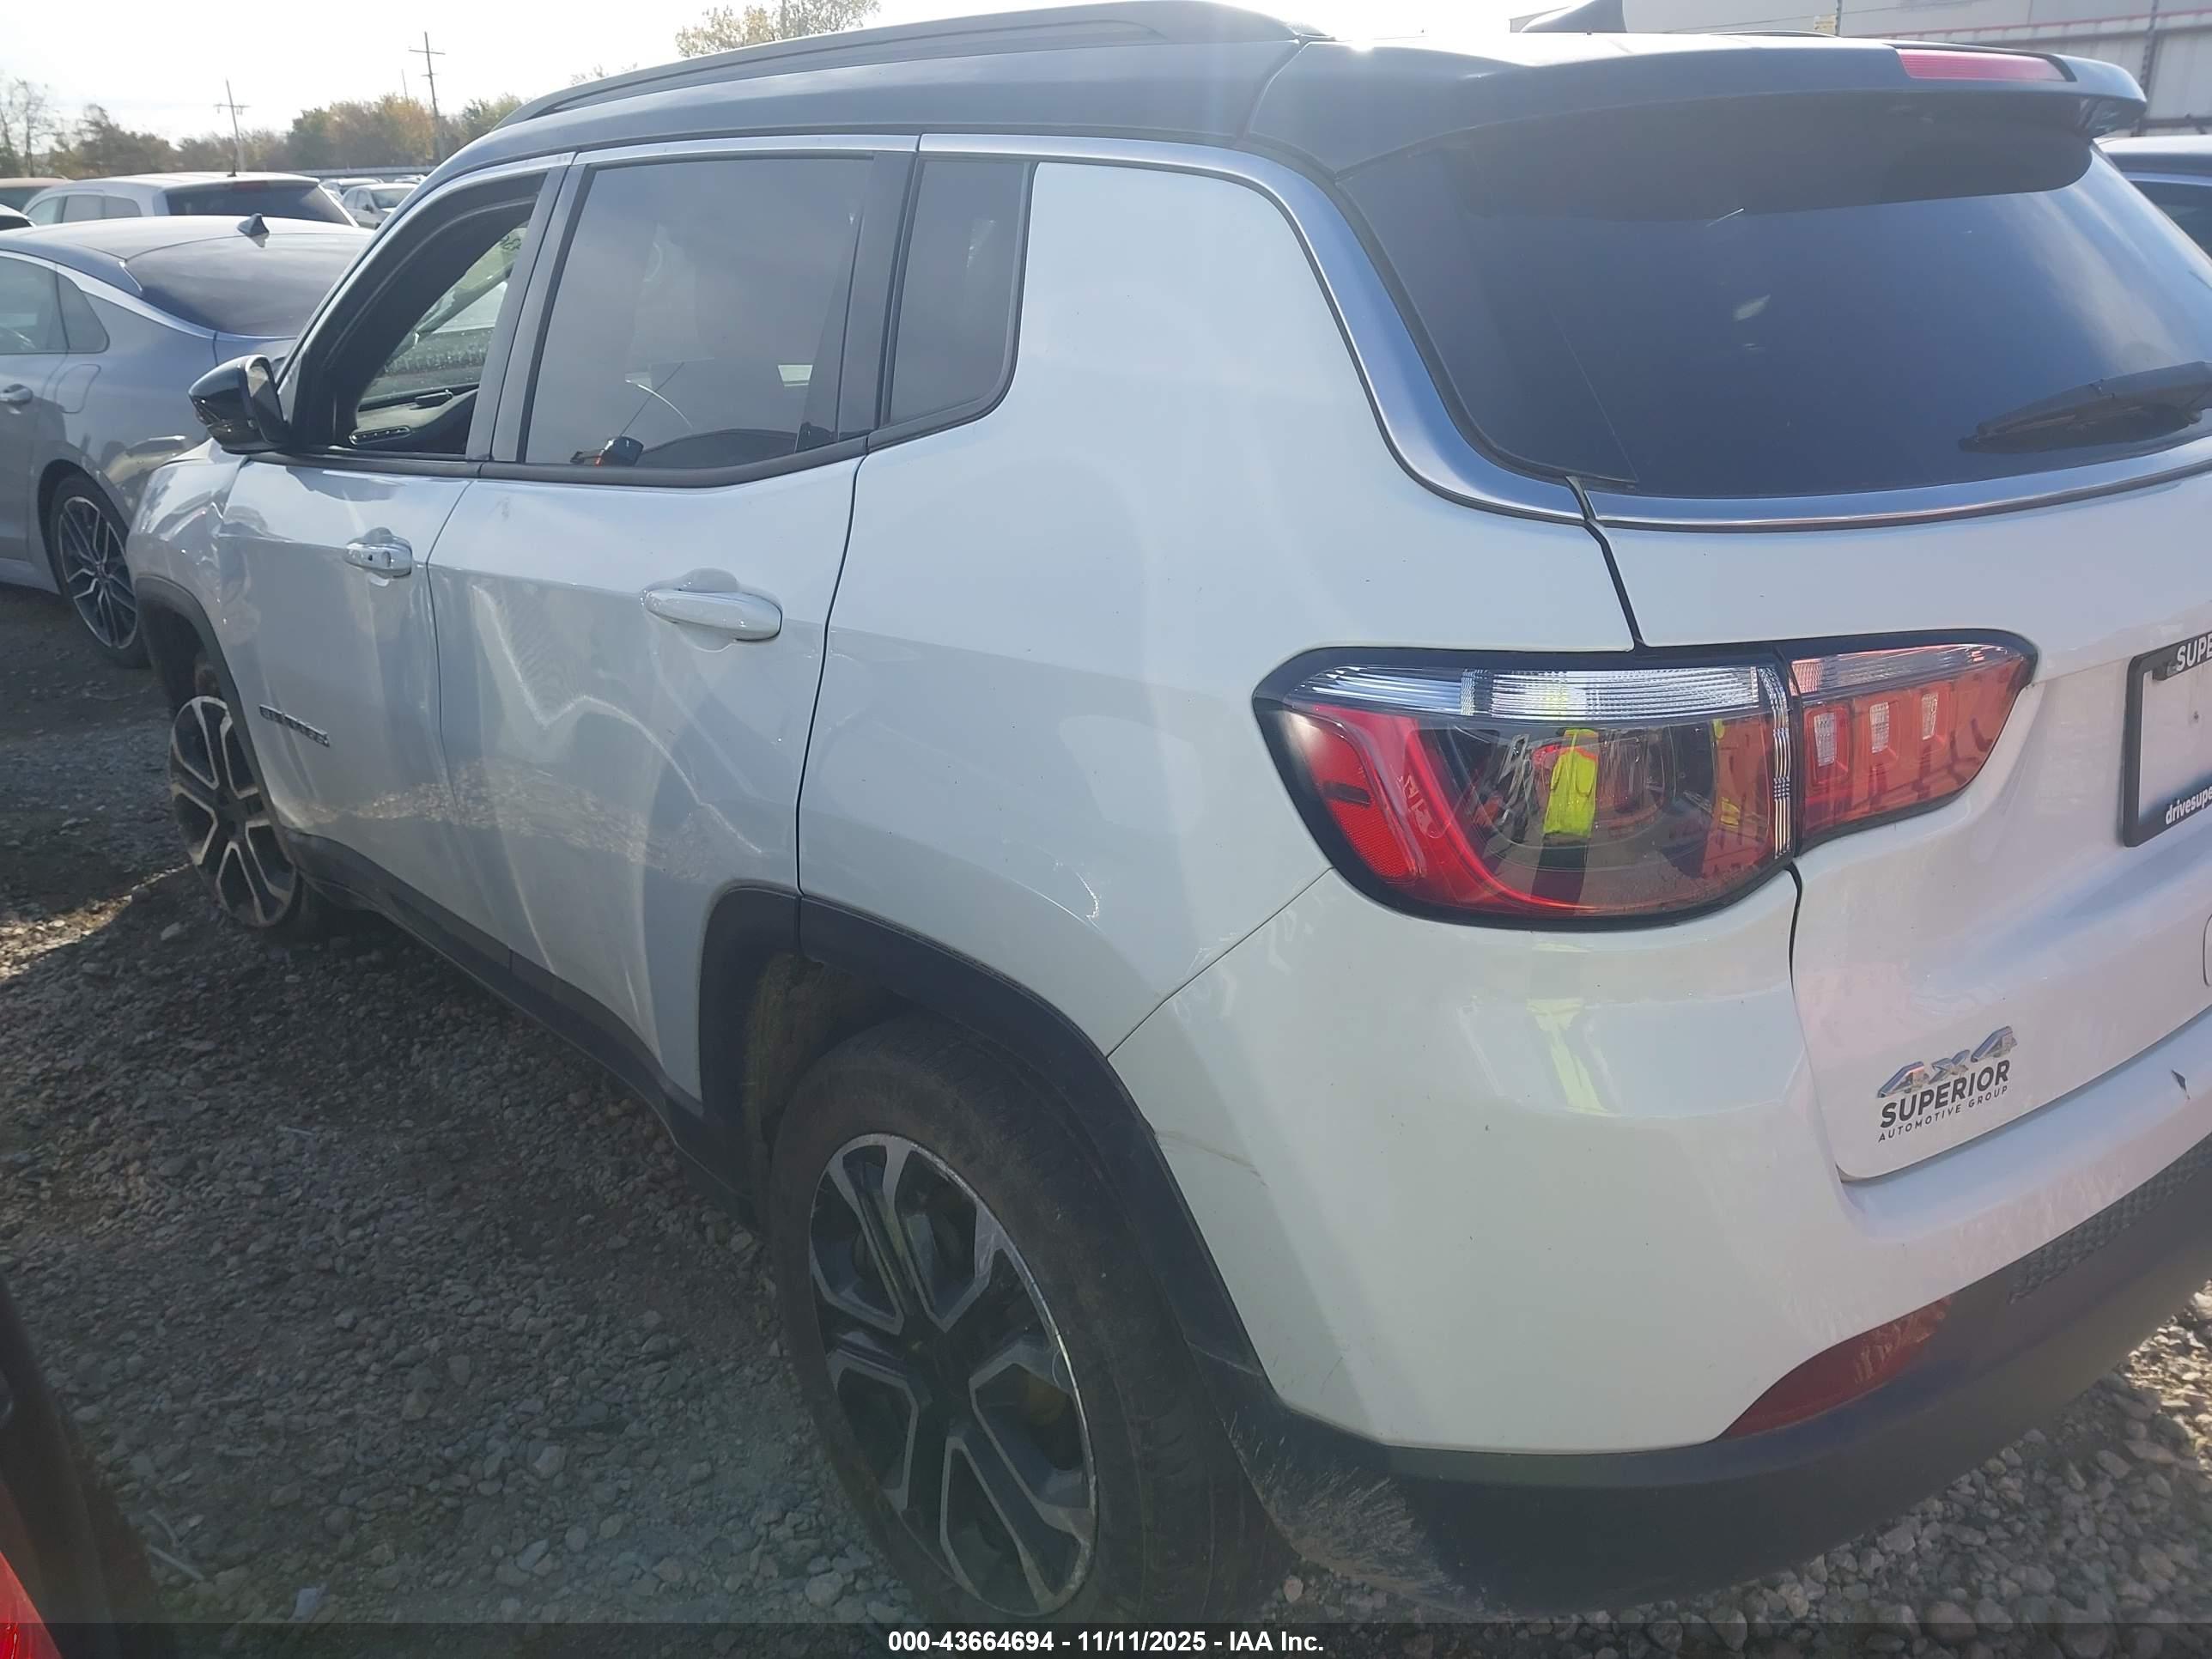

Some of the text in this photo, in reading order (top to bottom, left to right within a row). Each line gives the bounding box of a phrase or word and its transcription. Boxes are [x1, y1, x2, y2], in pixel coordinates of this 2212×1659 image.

[1878, 1085, 2008, 1143] AUTOMOTIVE GROUP
[1880, 1060, 2011, 1129] SUPERIOR
